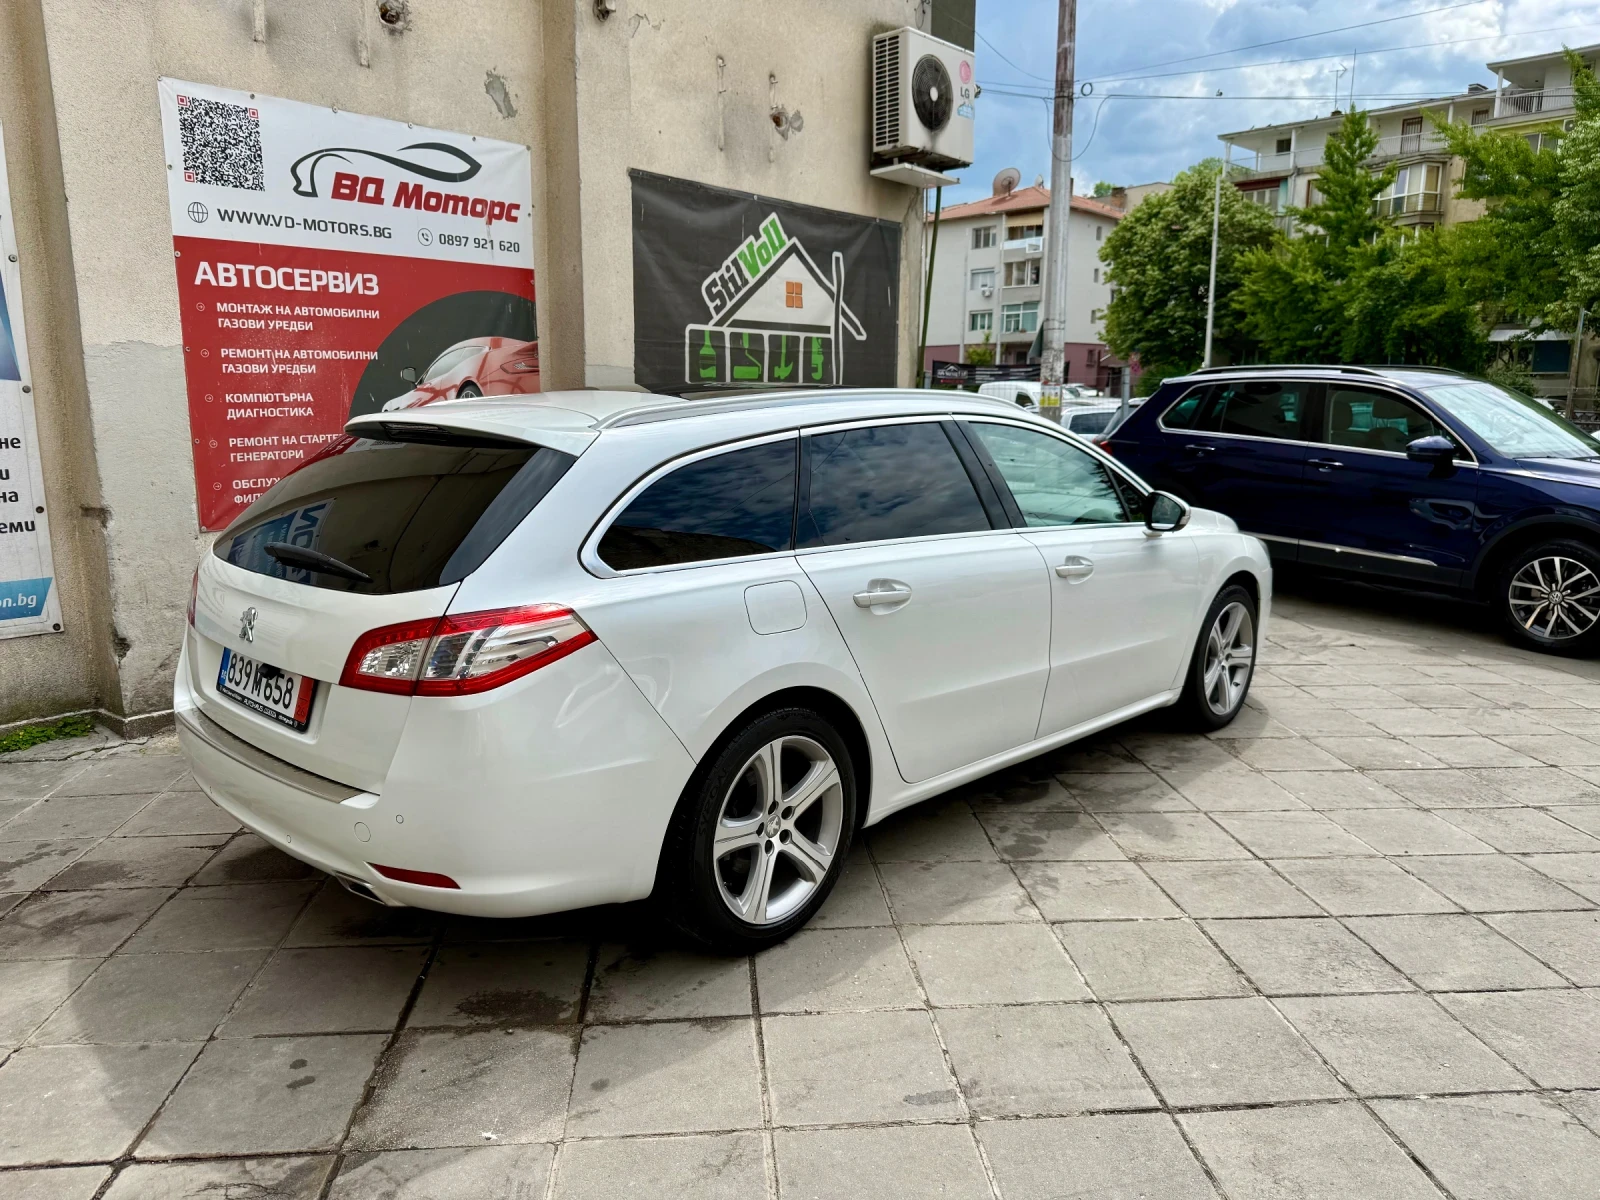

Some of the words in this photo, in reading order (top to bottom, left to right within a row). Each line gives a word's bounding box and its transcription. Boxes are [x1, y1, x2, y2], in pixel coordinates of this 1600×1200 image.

[960, 86, 970, 99] LG
[393, 181, 521, 226] Моторс
[217, 208, 392, 240] WWW.VD-MOTORS.BG
[438, 233, 469, 247] 0897
[473, 237, 494, 251] 921
[499, 240, 520, 253] 620
[705, 217, 787, 317] StilVoll
[194, 261, 379, 296] АВТОСЕРВИЗ
[216, 302, 274, 315] МОНТАЖ
[275, 305, 292, 316] НА
[293, 306, 380, 319] АВТОМОБИЛНИ
[217, 319, 265, 330] ГАЗОВИ
[267, 320, 313, 332] УРЕДБИ
[220, 348, 271, 359] РЕМОНТ
[275, 349, 291, 360] НА
[292, 349, 379, 360] АВТОМОБИЛНИ
[222, 363, 269, 374] ГАЗОВИ
[271, 364, 316, 376] УРЕДБИ
[225, 392, 314, 403] КОМПЮТЪРНА
[226, 407, 314, 420] ДИАГНОСТИКА
[228, 436, 279, 448] РЕМОНТ
[281, 435, 298, 445] НА
[230, 449, 304, 463] ГЕНЕРАТОРИ
